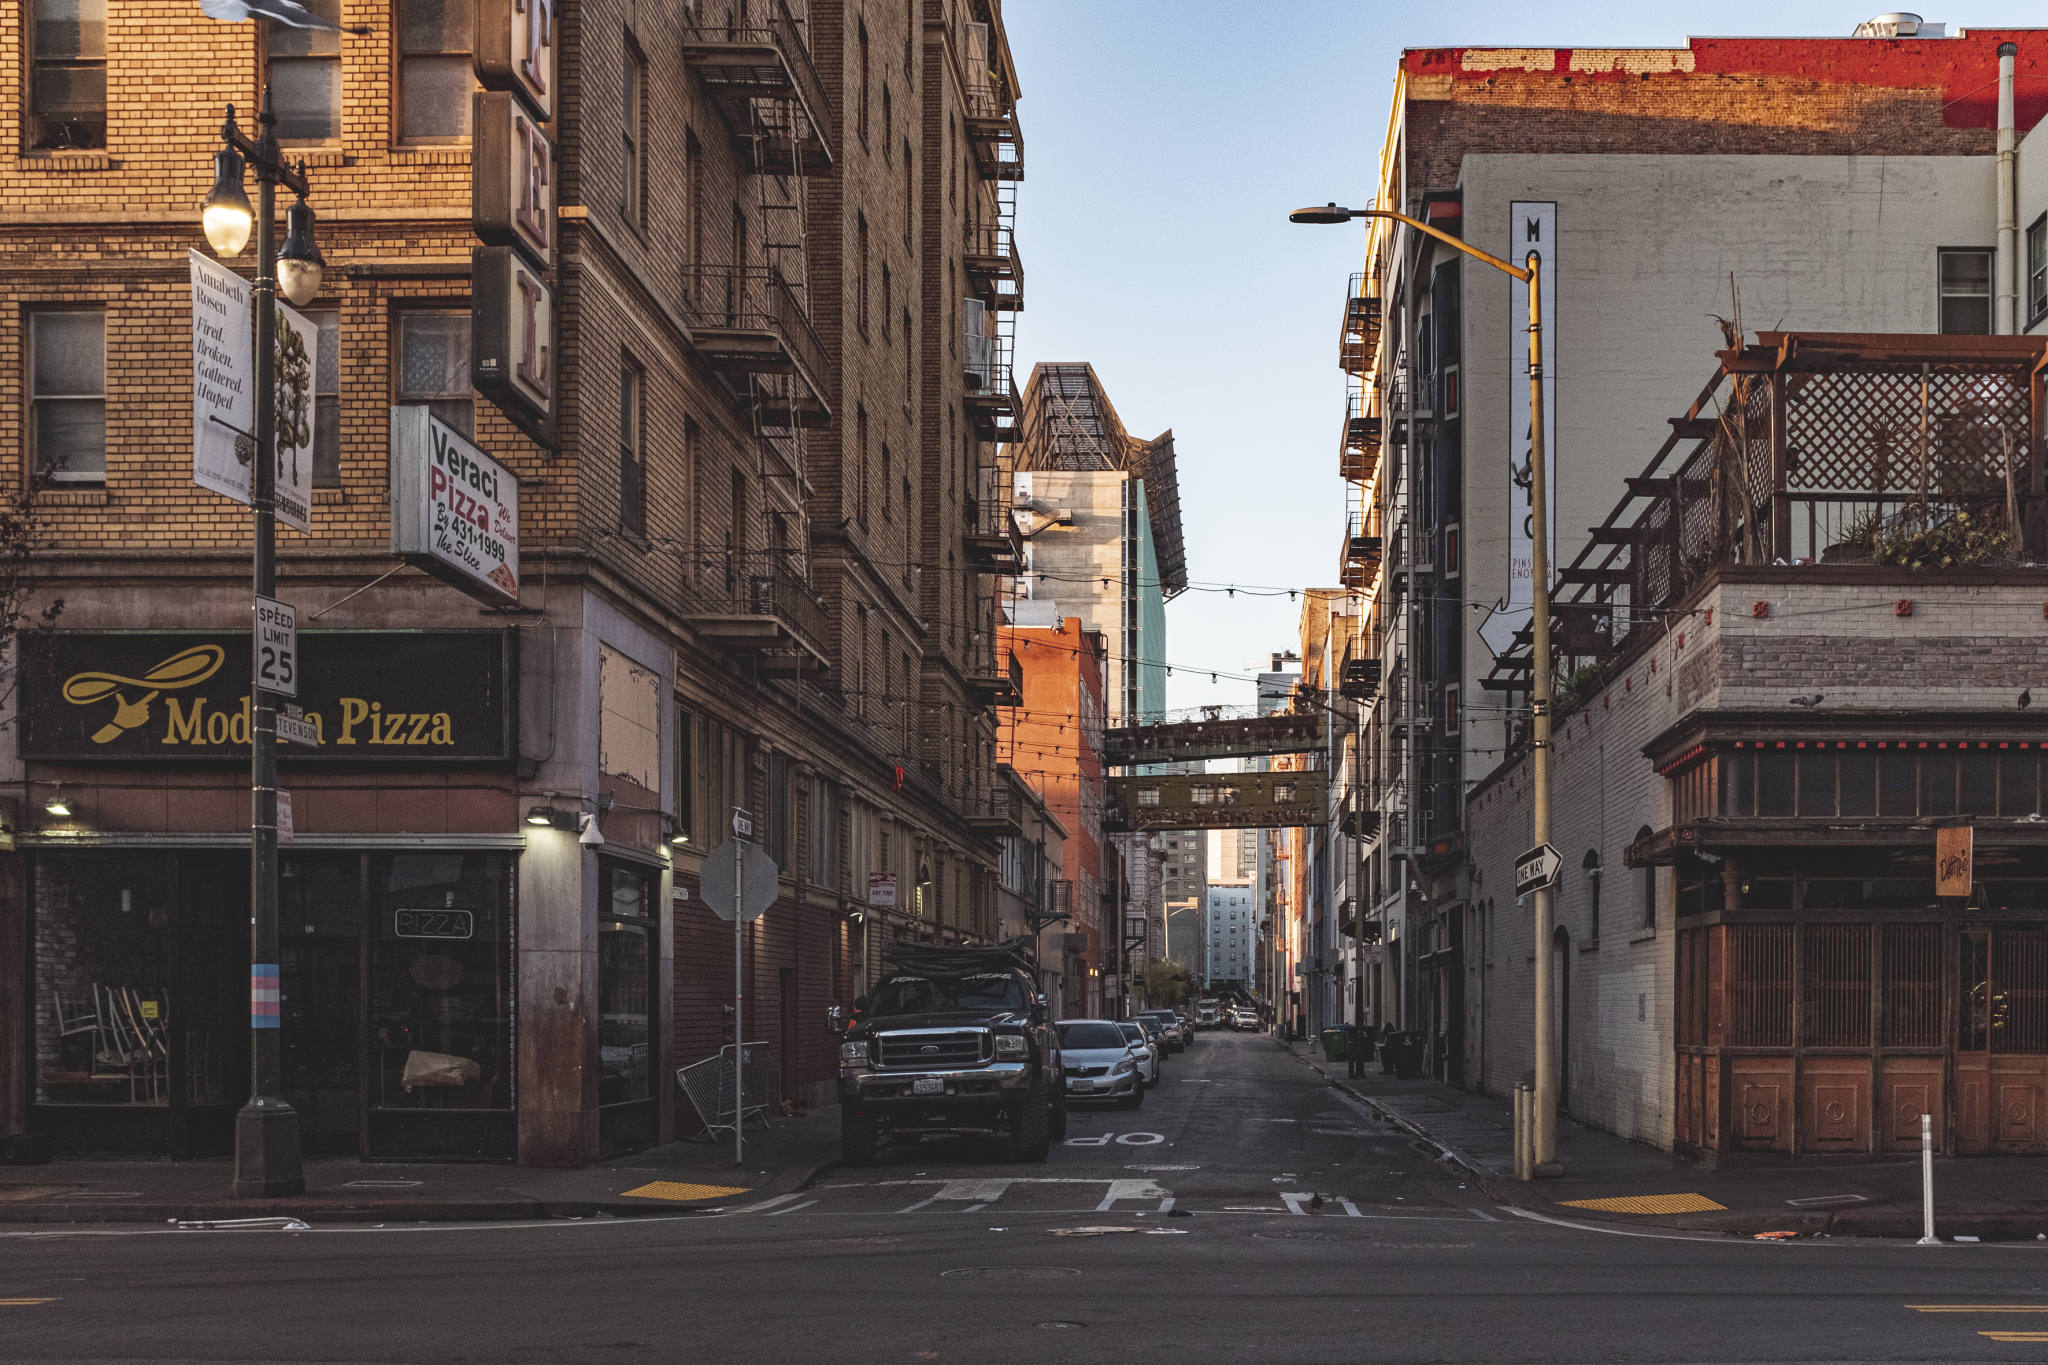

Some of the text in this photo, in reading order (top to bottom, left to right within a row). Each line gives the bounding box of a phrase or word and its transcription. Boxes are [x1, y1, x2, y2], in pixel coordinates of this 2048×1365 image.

[196, 264, 244, 304] Annabeth
[196, 286, 227, 316] Rosen
[196, 381, 234, 410] Heaped
[431, 424, 498, 503] Veraci
[430, 464, 489, 533] Pizza
[437, 502, 450, 529] By
[497, 502, 512, 524] We
[494, 519, 516, 545] Deliver
[434, 524, 481, 571] The Slice
[259, 607, 294, 629] SPEED
[263, 627, 290, 647] LIMIT
[260, 646, 293, 685] 25
[162, 696, 455, 745] Moda Pizza
[278, 717, 318, 742] TEVENSON
[1517, 858, 1544, 884] ONE WAY
[400, 913, 468, 935] PIZZA
